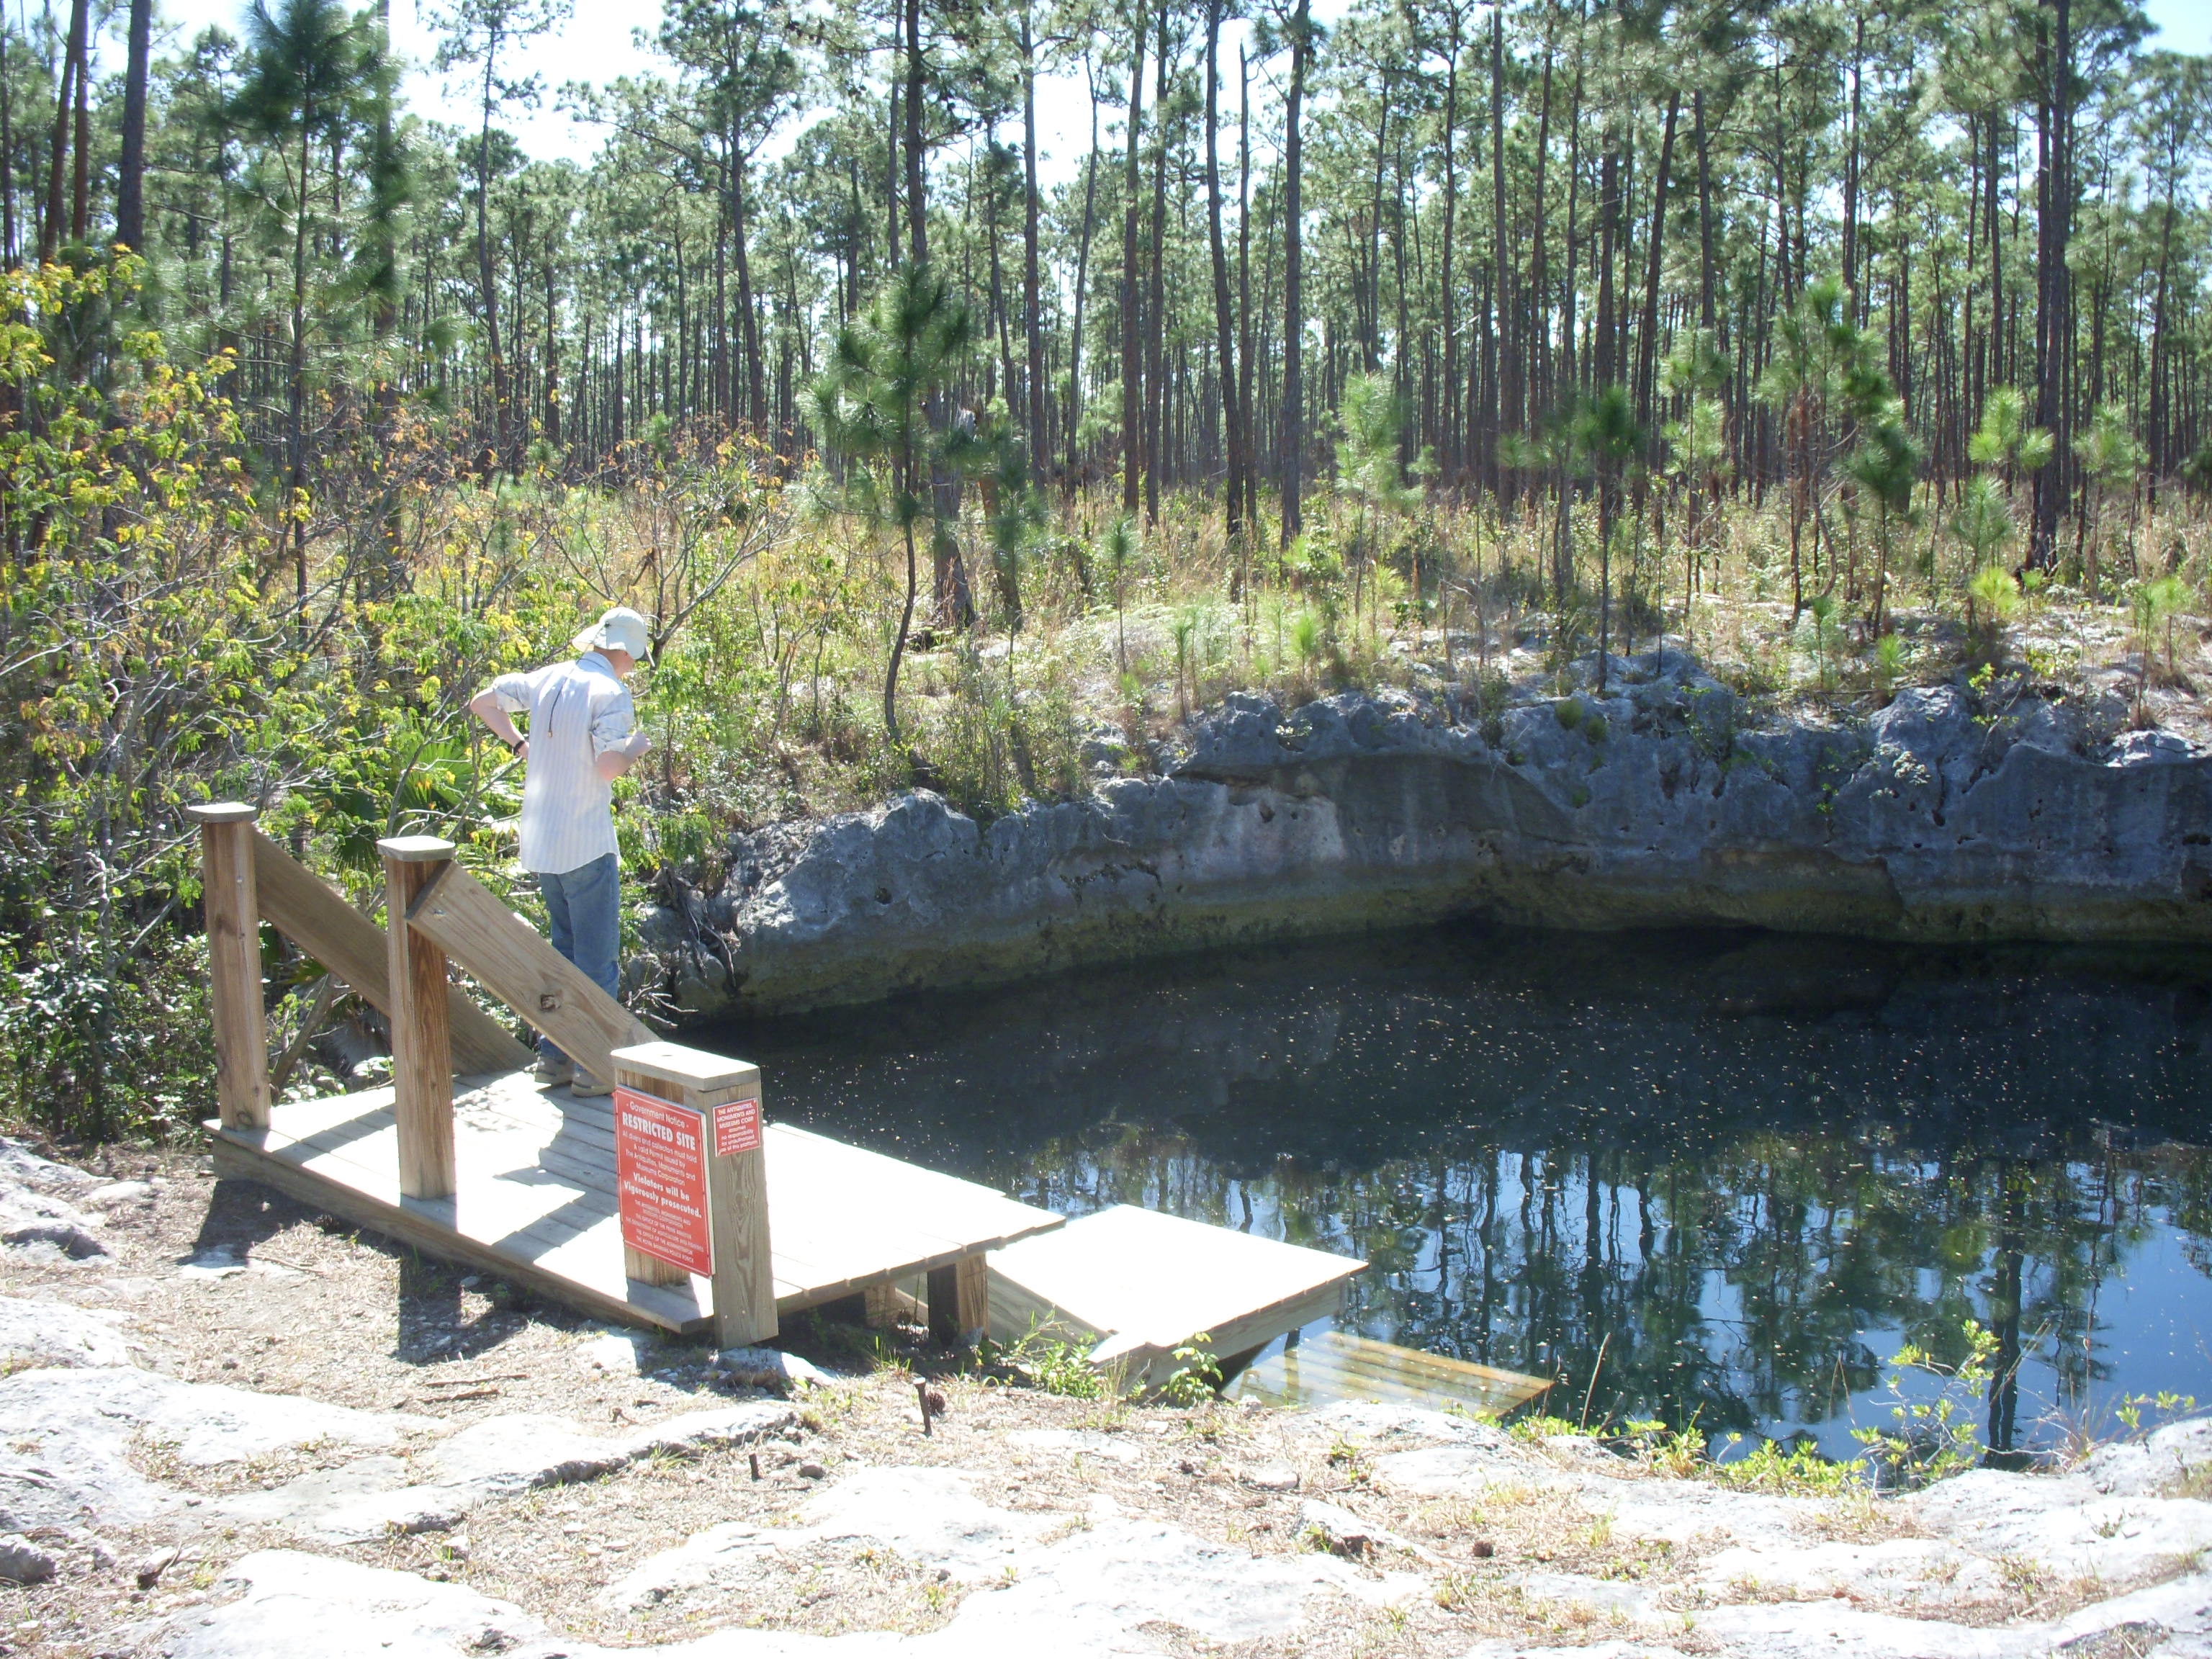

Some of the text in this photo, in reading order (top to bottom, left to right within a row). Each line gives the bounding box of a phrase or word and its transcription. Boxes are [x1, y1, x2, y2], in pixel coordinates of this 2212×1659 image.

[630, 1101, 685, 1128] Government Notice
[622, 1111, 696, 1150] RESTRICTED SITE
[638, 1145, 648, 1154] valid
[680, 1160, 685, 1169] by
[675, 1149, 685, 1158] must
[659, 1161, 685, 1176] Monuments
[686, 1171, 695, 1180] and
[624, 1179, 701, 1220] Vigorously prosecuted.
[634, 1172, 689, 1200] Violators will be
